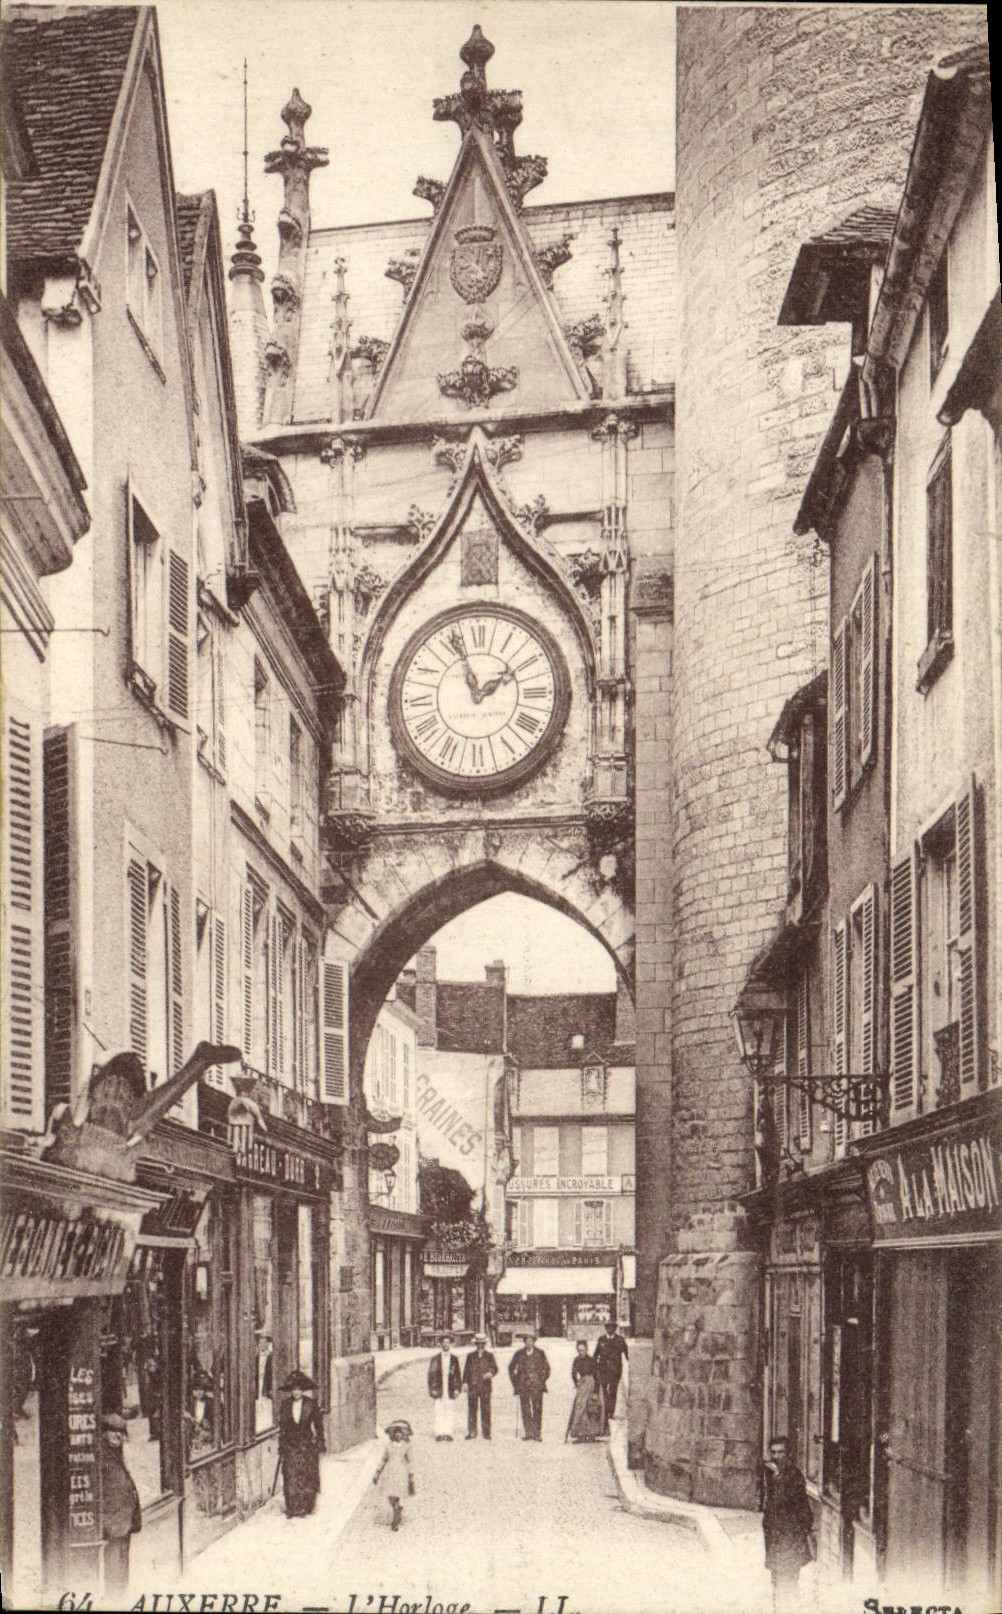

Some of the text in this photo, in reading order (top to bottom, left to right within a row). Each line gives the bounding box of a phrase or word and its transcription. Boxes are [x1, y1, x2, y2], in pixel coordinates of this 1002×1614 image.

[415, 1073, 483, 1157] GRAINES
[897, 1153, 914, 1222] A
[911, 1169, 934, 1220] LA
[929, 1137, 999, 1217] MAISON
